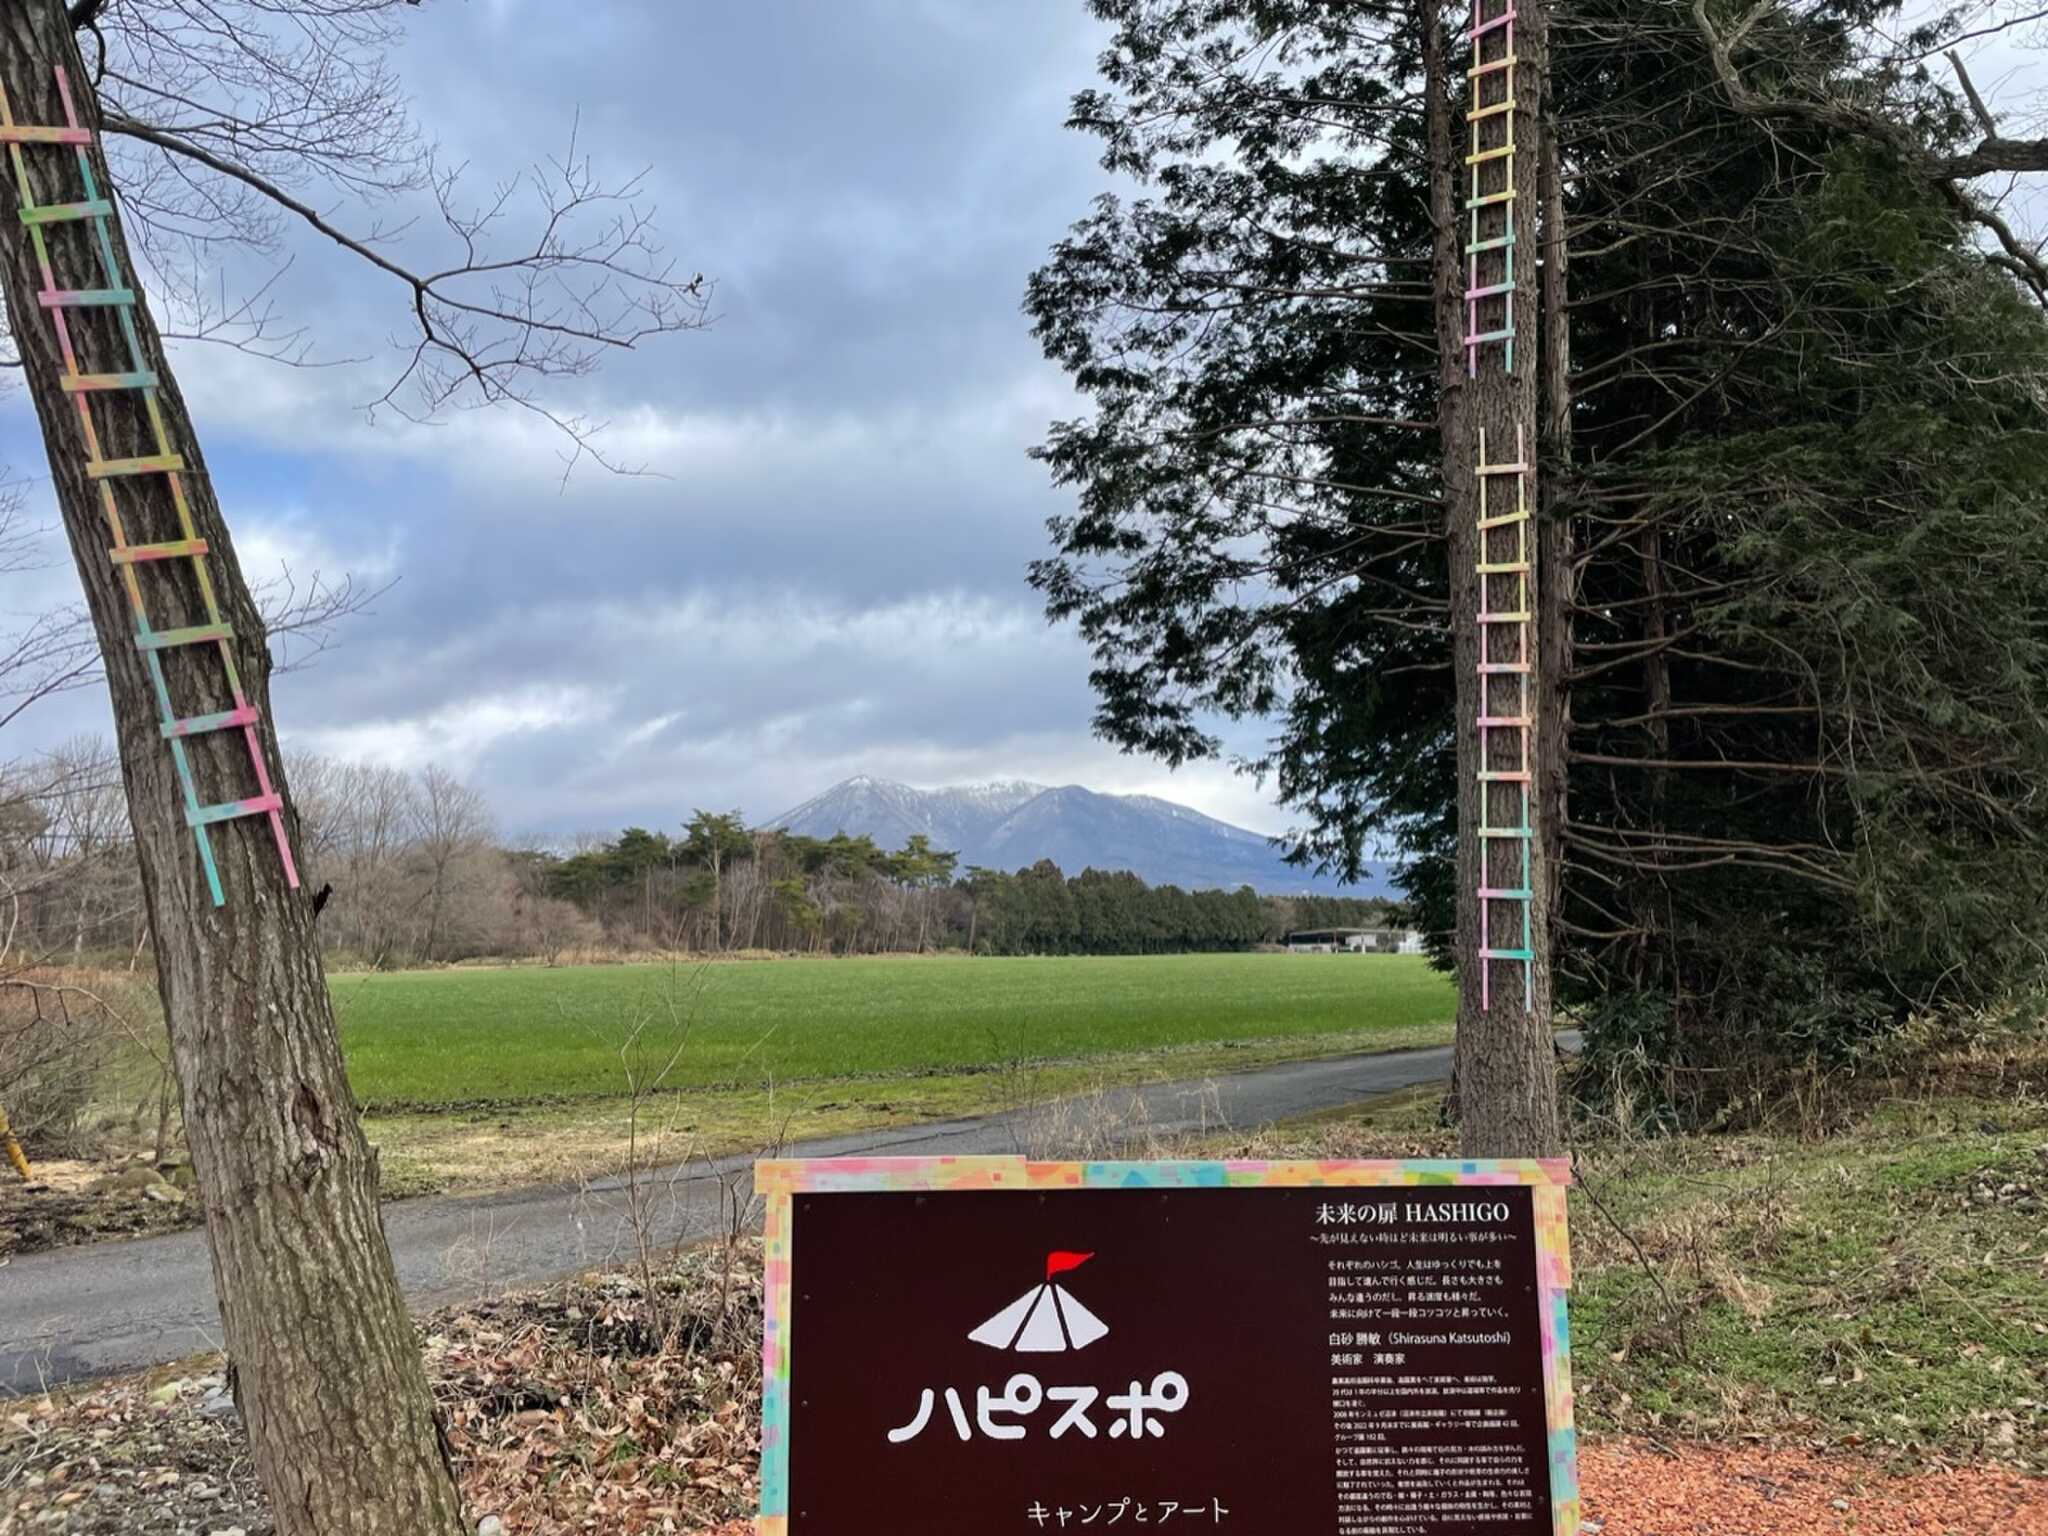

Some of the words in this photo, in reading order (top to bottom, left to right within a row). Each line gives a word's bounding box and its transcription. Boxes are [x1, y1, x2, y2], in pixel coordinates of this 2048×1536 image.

[1316, 1202, 1397, 1224] 未来の扉
[1405, 1202, 1510, 1223] HASHIGO
[1328, 1332, 1354, 1346] 白砂
[1330, 1352, 1363, 1366] 美術家
[1373, 1352, 1406, 1365] 演奏家
[888, 1371, 1189, 1443] ハピスポ
[1028, 1497, 1229, 1527] キャンプとアート
